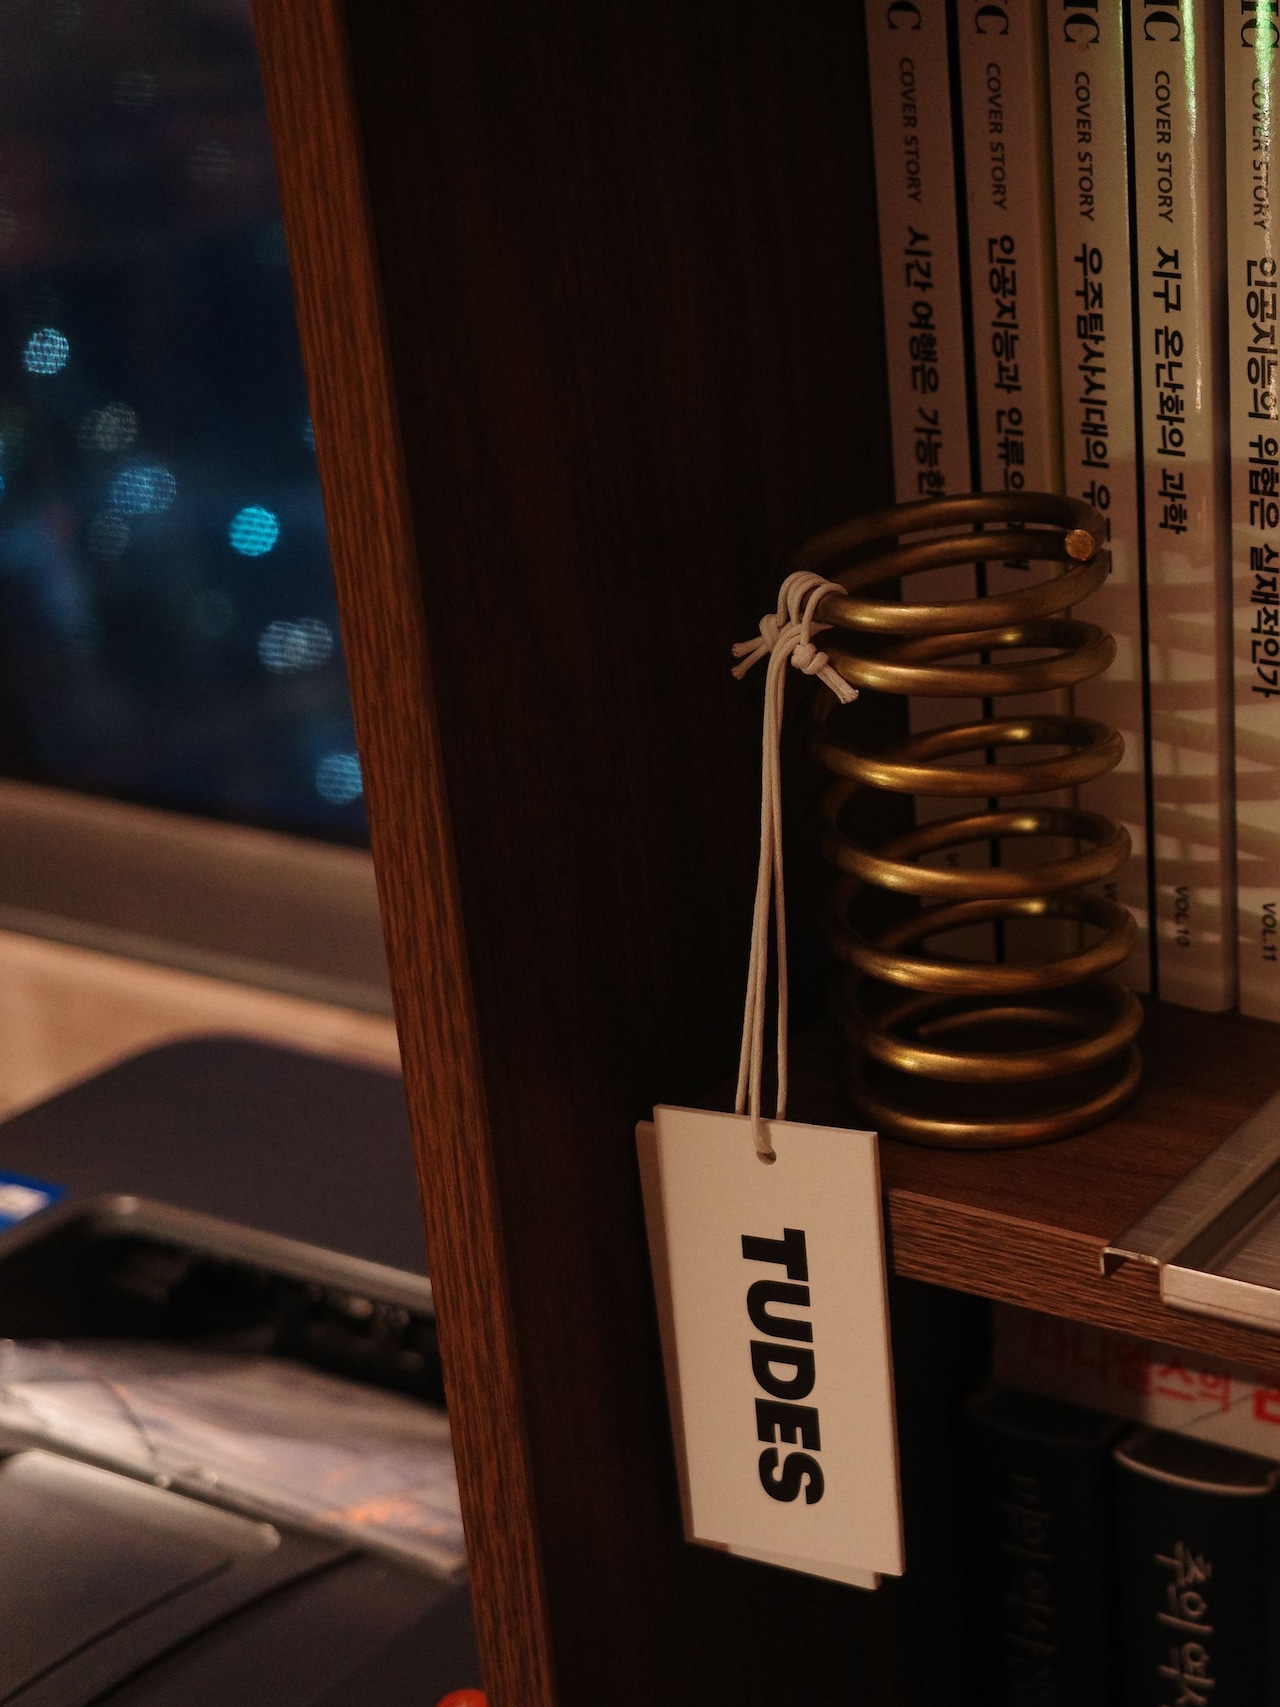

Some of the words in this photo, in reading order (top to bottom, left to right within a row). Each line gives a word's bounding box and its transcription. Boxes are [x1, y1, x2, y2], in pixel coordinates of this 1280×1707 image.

[899, 56, 918, 128] COVER
[986, 62, 1004, 134] COVER
[1074, 71, 1092, 144] COVER
[1154, 70, 1172, 144] COVER
[903, 135, 922, 203] STORY
[989, 141, 1007, 211] STORY
[1076, 151, 1095, 222] STORY
[1156, 151, 1174, 223] STORY
[1252, 159, 1269, 230] STORY
[903, 225, 934, 292] 시간
[1152, 246, 1182, 314] 지구
[908, 300, 939, 395] 여행은
[987, 234, 1022, 394] 인공지능과
[1245, 257, 1278, 420] 인공지능의
[1073, 242, 1110, 470] 우주탐사시대의
[1154, 325, 1186, 458] 온난화의
[1157, 468, 1188, 535] 과학
[1248, 434, 1280, 530] 위험은
[1249, 543, 1280, 699] 실재적인가
[1260, 903, 1278, 963] VOL.11
[740, 1227, 825, 1505] TUDES
